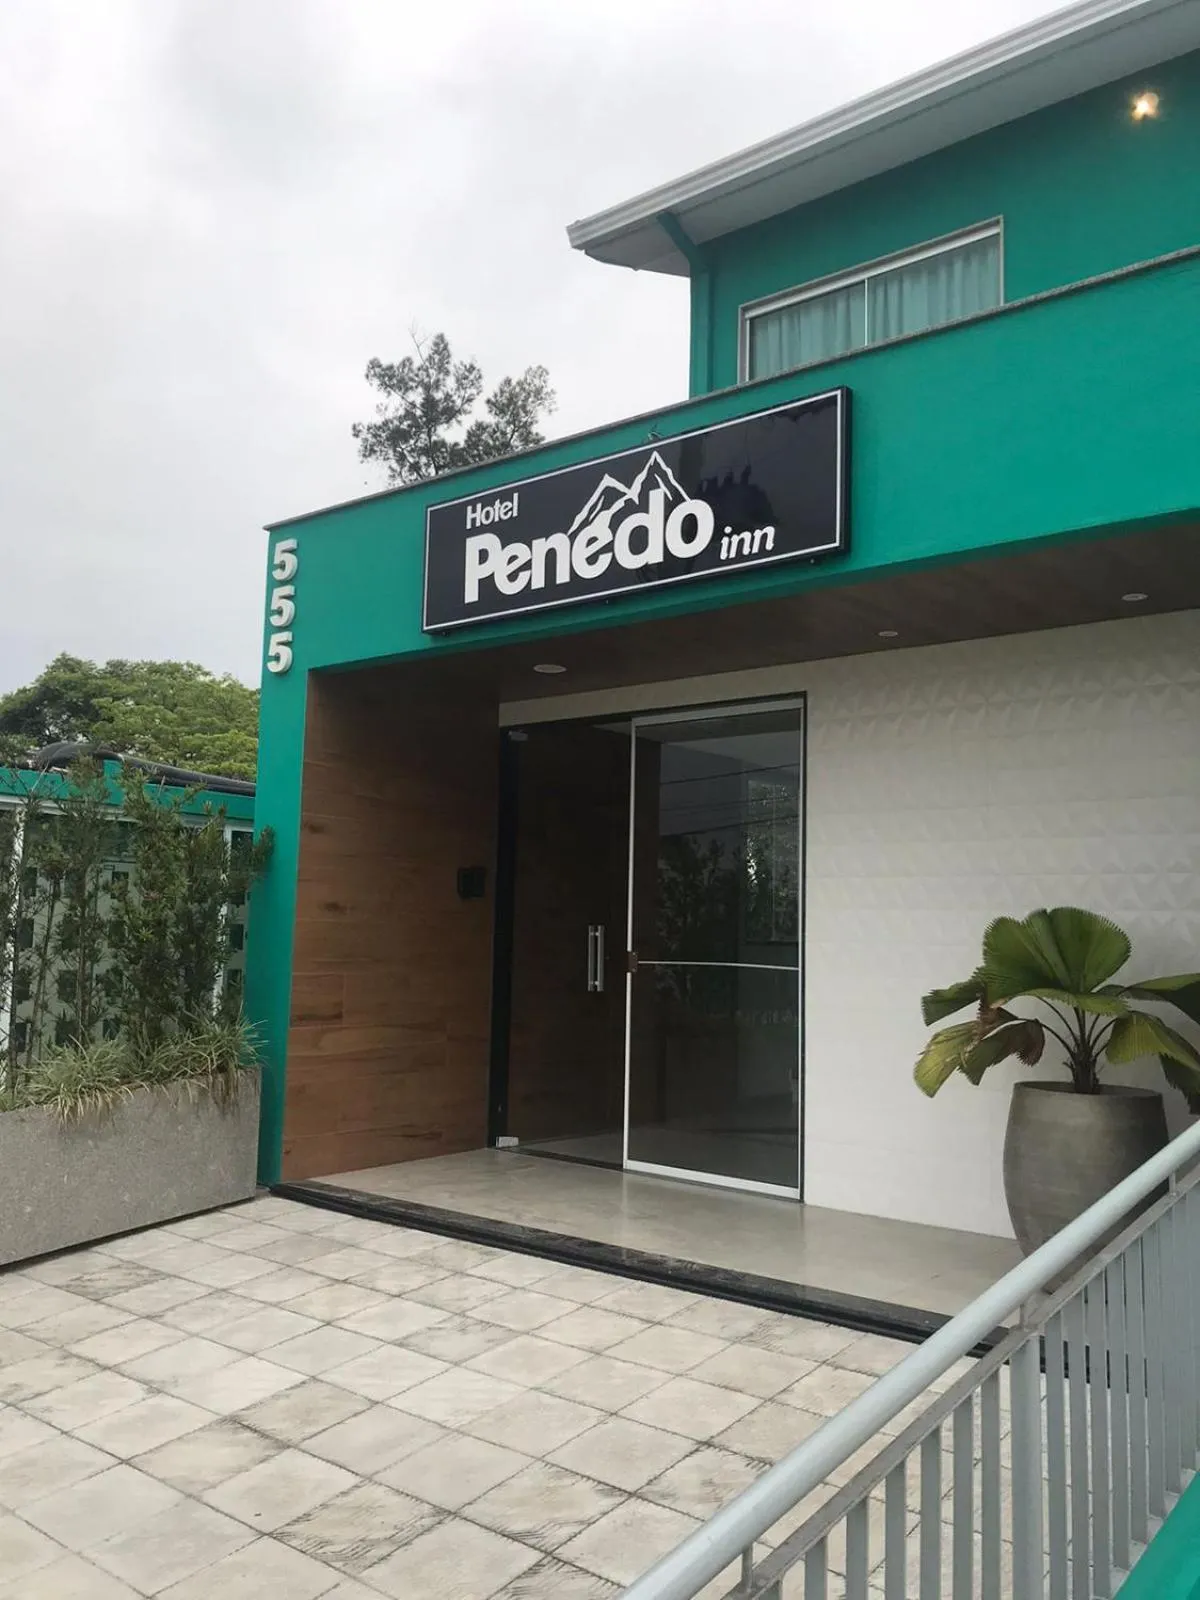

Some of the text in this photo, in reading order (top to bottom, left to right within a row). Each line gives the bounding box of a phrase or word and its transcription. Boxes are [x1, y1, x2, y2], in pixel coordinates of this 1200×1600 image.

[464, 489, 775, 604] Penedo inn
[465, 493, 519, 530] Hotel
[267, 538, 298, 674] 555
